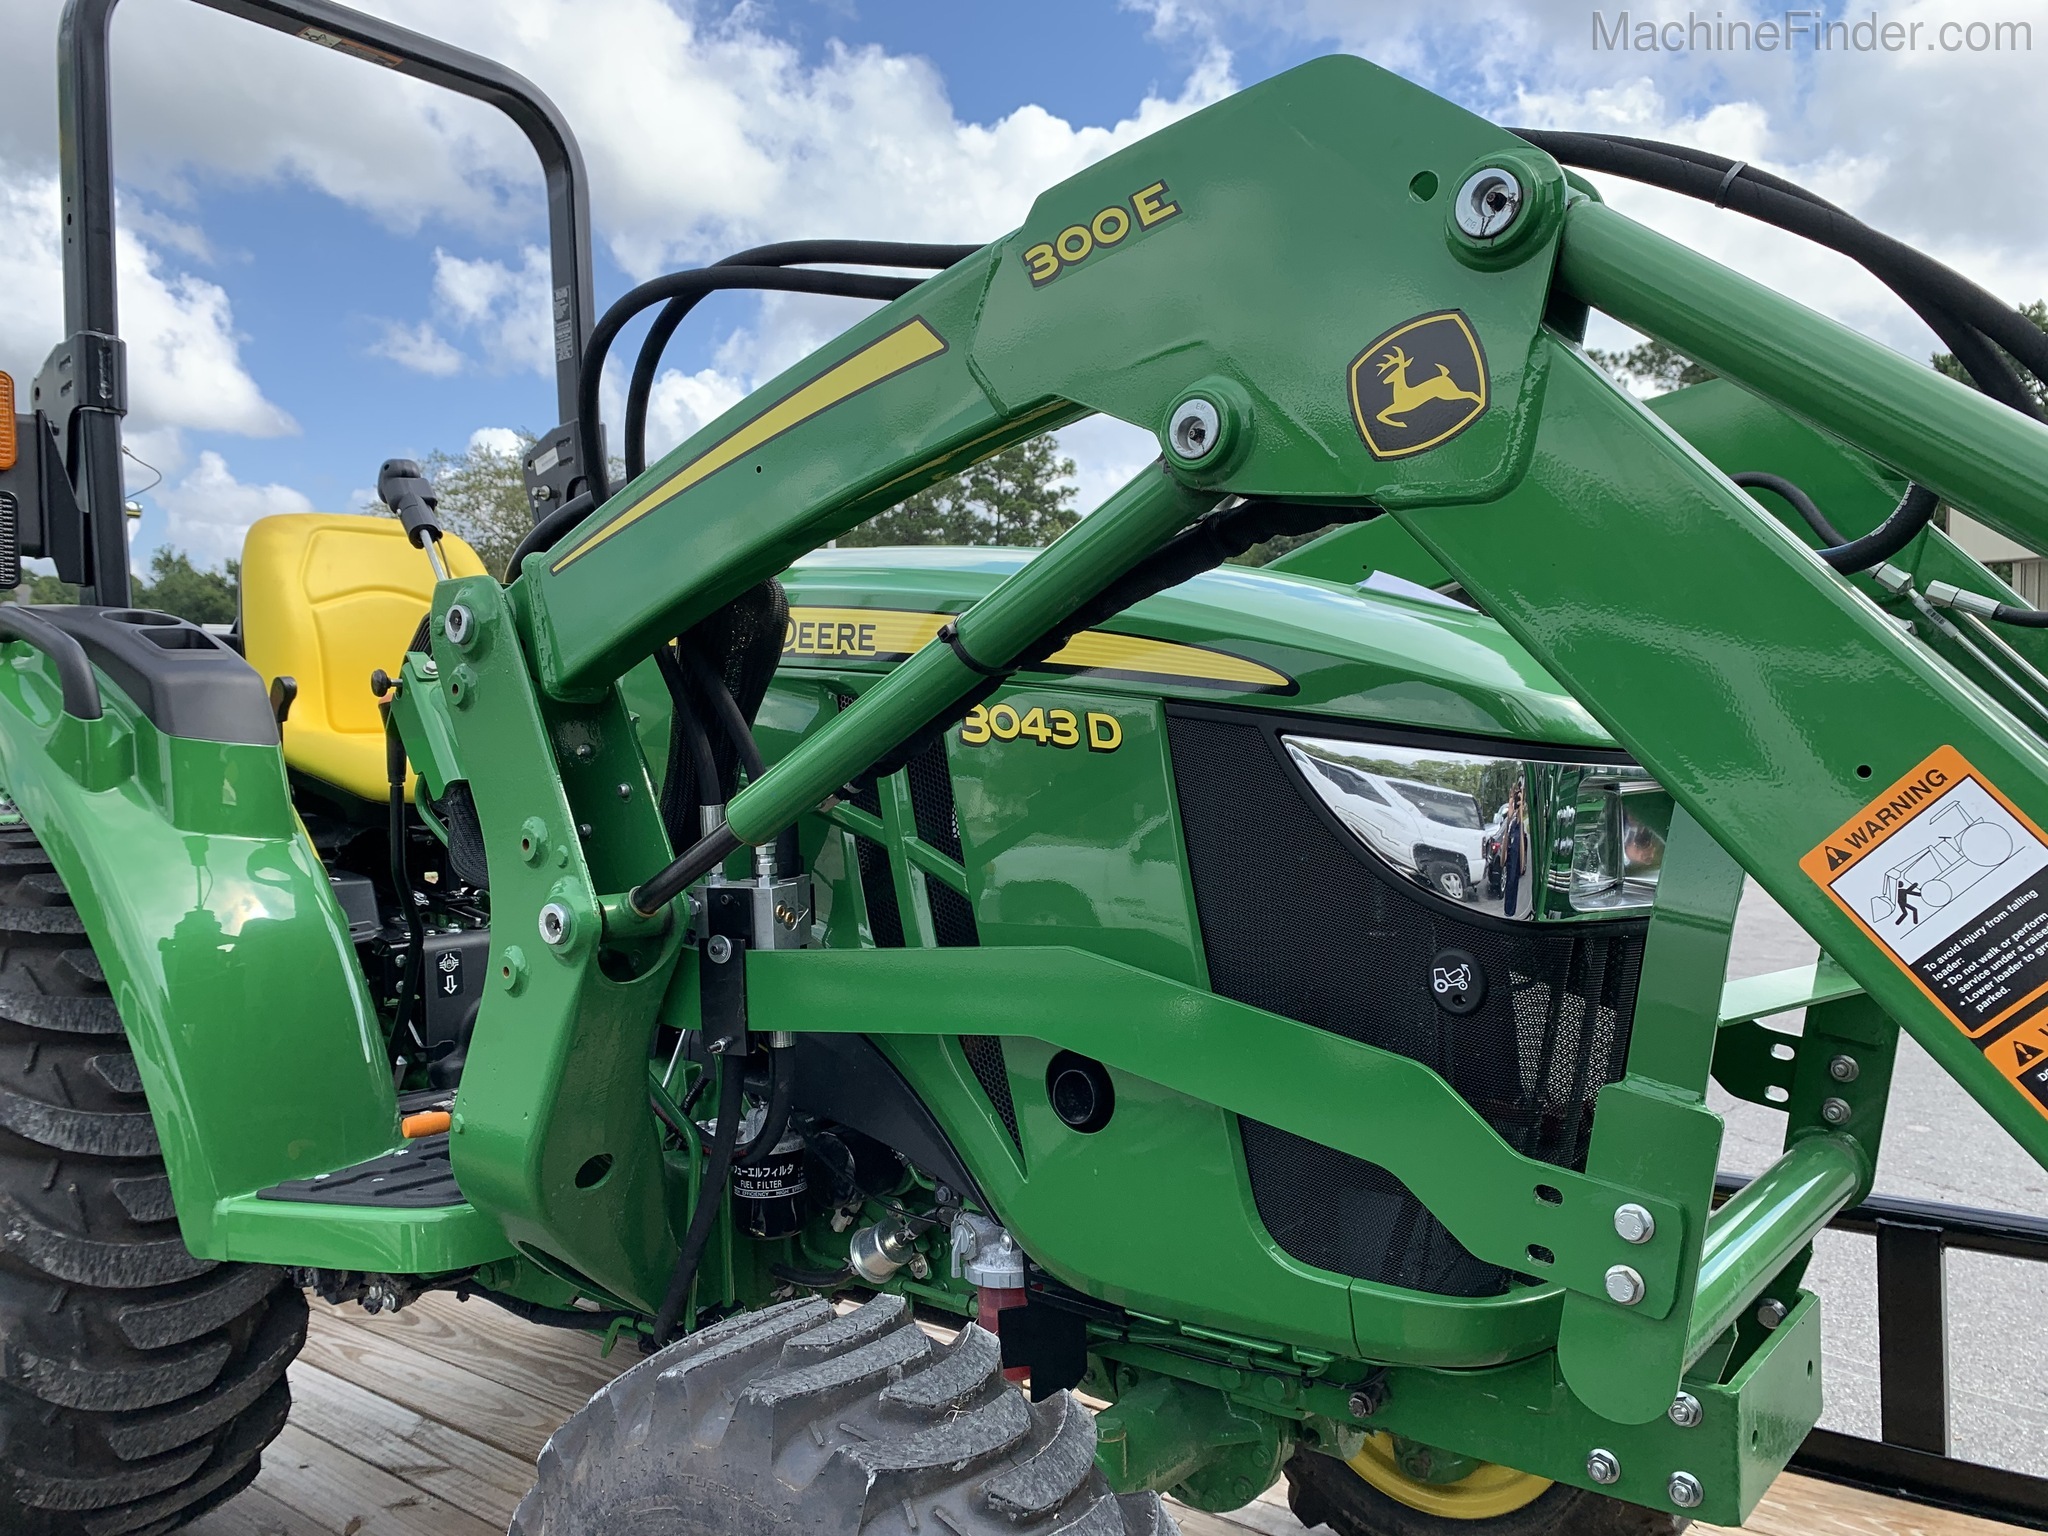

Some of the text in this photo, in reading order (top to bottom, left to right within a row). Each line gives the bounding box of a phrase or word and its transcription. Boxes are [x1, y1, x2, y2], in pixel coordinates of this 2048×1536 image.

[1023, 180, 1181, 285] 300 E
[960, 703, 1123, 751] 3043 D
[1844, 769, 1948, 850] WARNING
[1923, 889, 2039, 972] To avoid injury from falling
[1947, 912, 2048, 986] Do not walk or perform
[1958, 922, 2048, 994] service under a raise
[1932, 957, 1965, 982] loader:
[1965, 942, 2048, 1003] Lower loader to gro
[1975, 985, 2011, 1013] parked.
[740, 1180, 754, 1189] FUEL
[757, 1180, 782, 1190] FILTER
